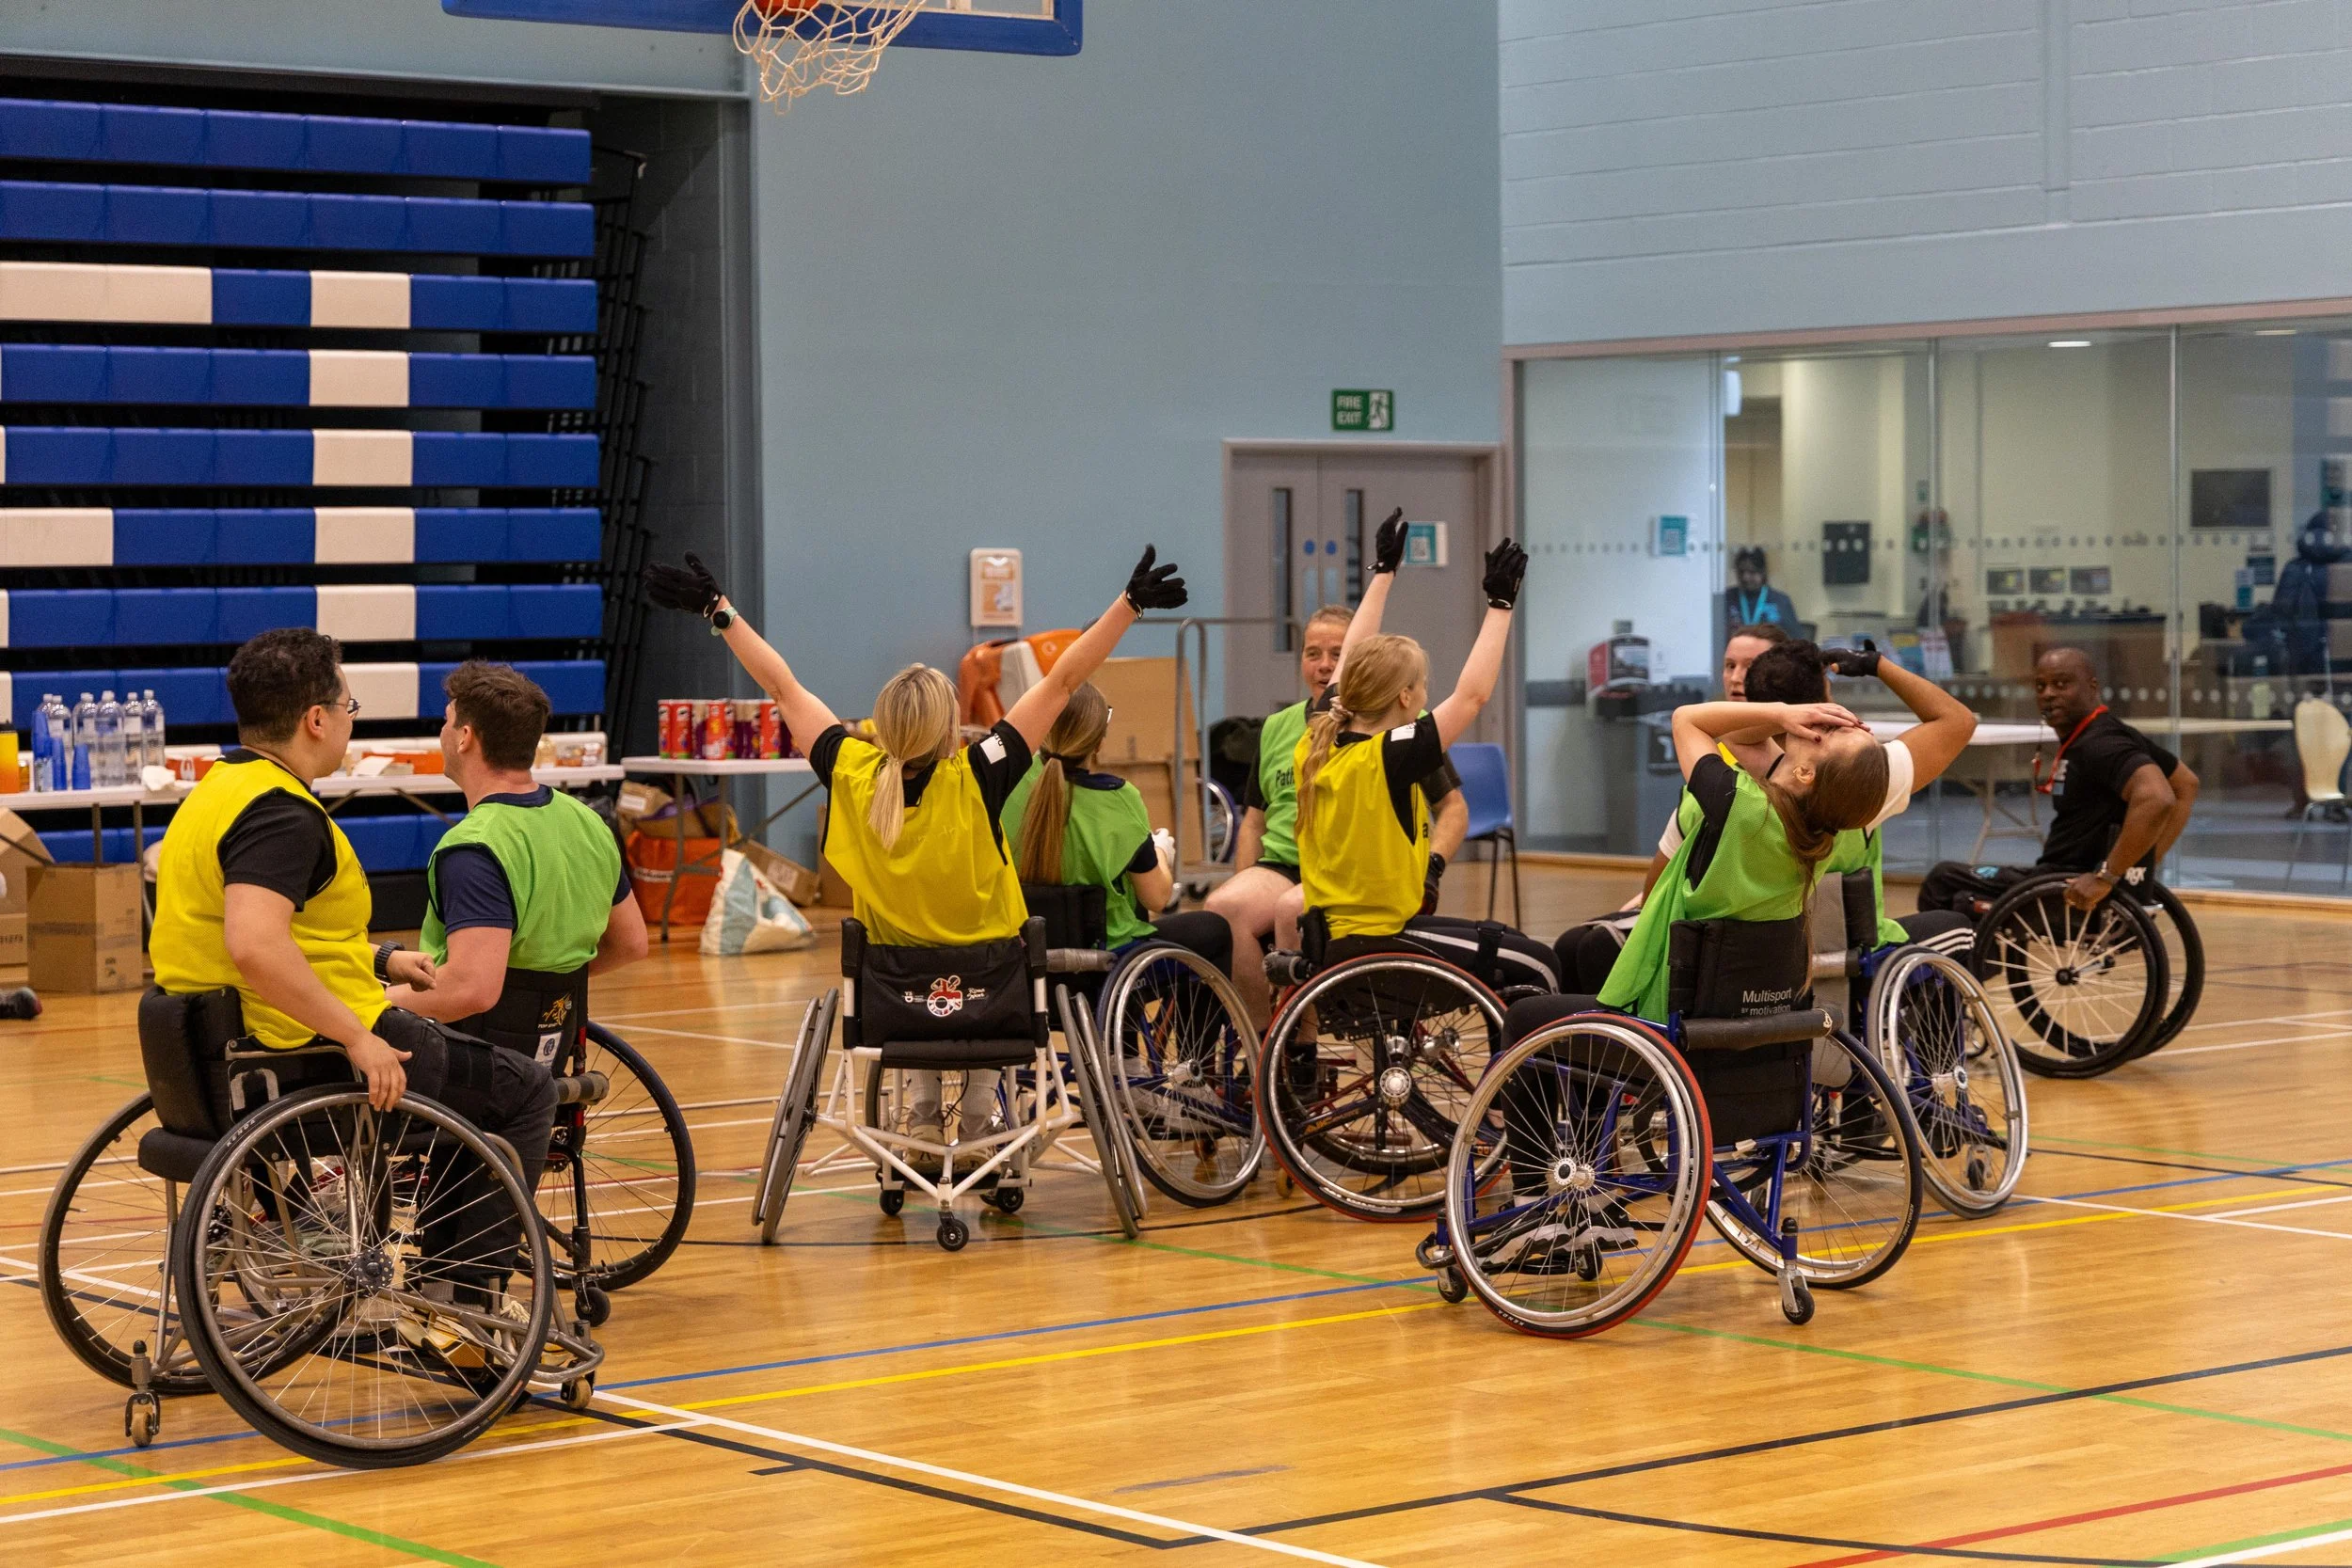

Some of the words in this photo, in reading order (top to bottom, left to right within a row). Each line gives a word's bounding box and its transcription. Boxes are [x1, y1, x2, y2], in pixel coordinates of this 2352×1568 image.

[1337, 395, 1362, 409] FIRE
[1337, 411, 1362, 425] EXIT
[1741, 987, 1791, 1003] Multisport
[1749, 1004, 1791, 1016] motivation
[1498, 1309, 1524, 1326] KENDA
